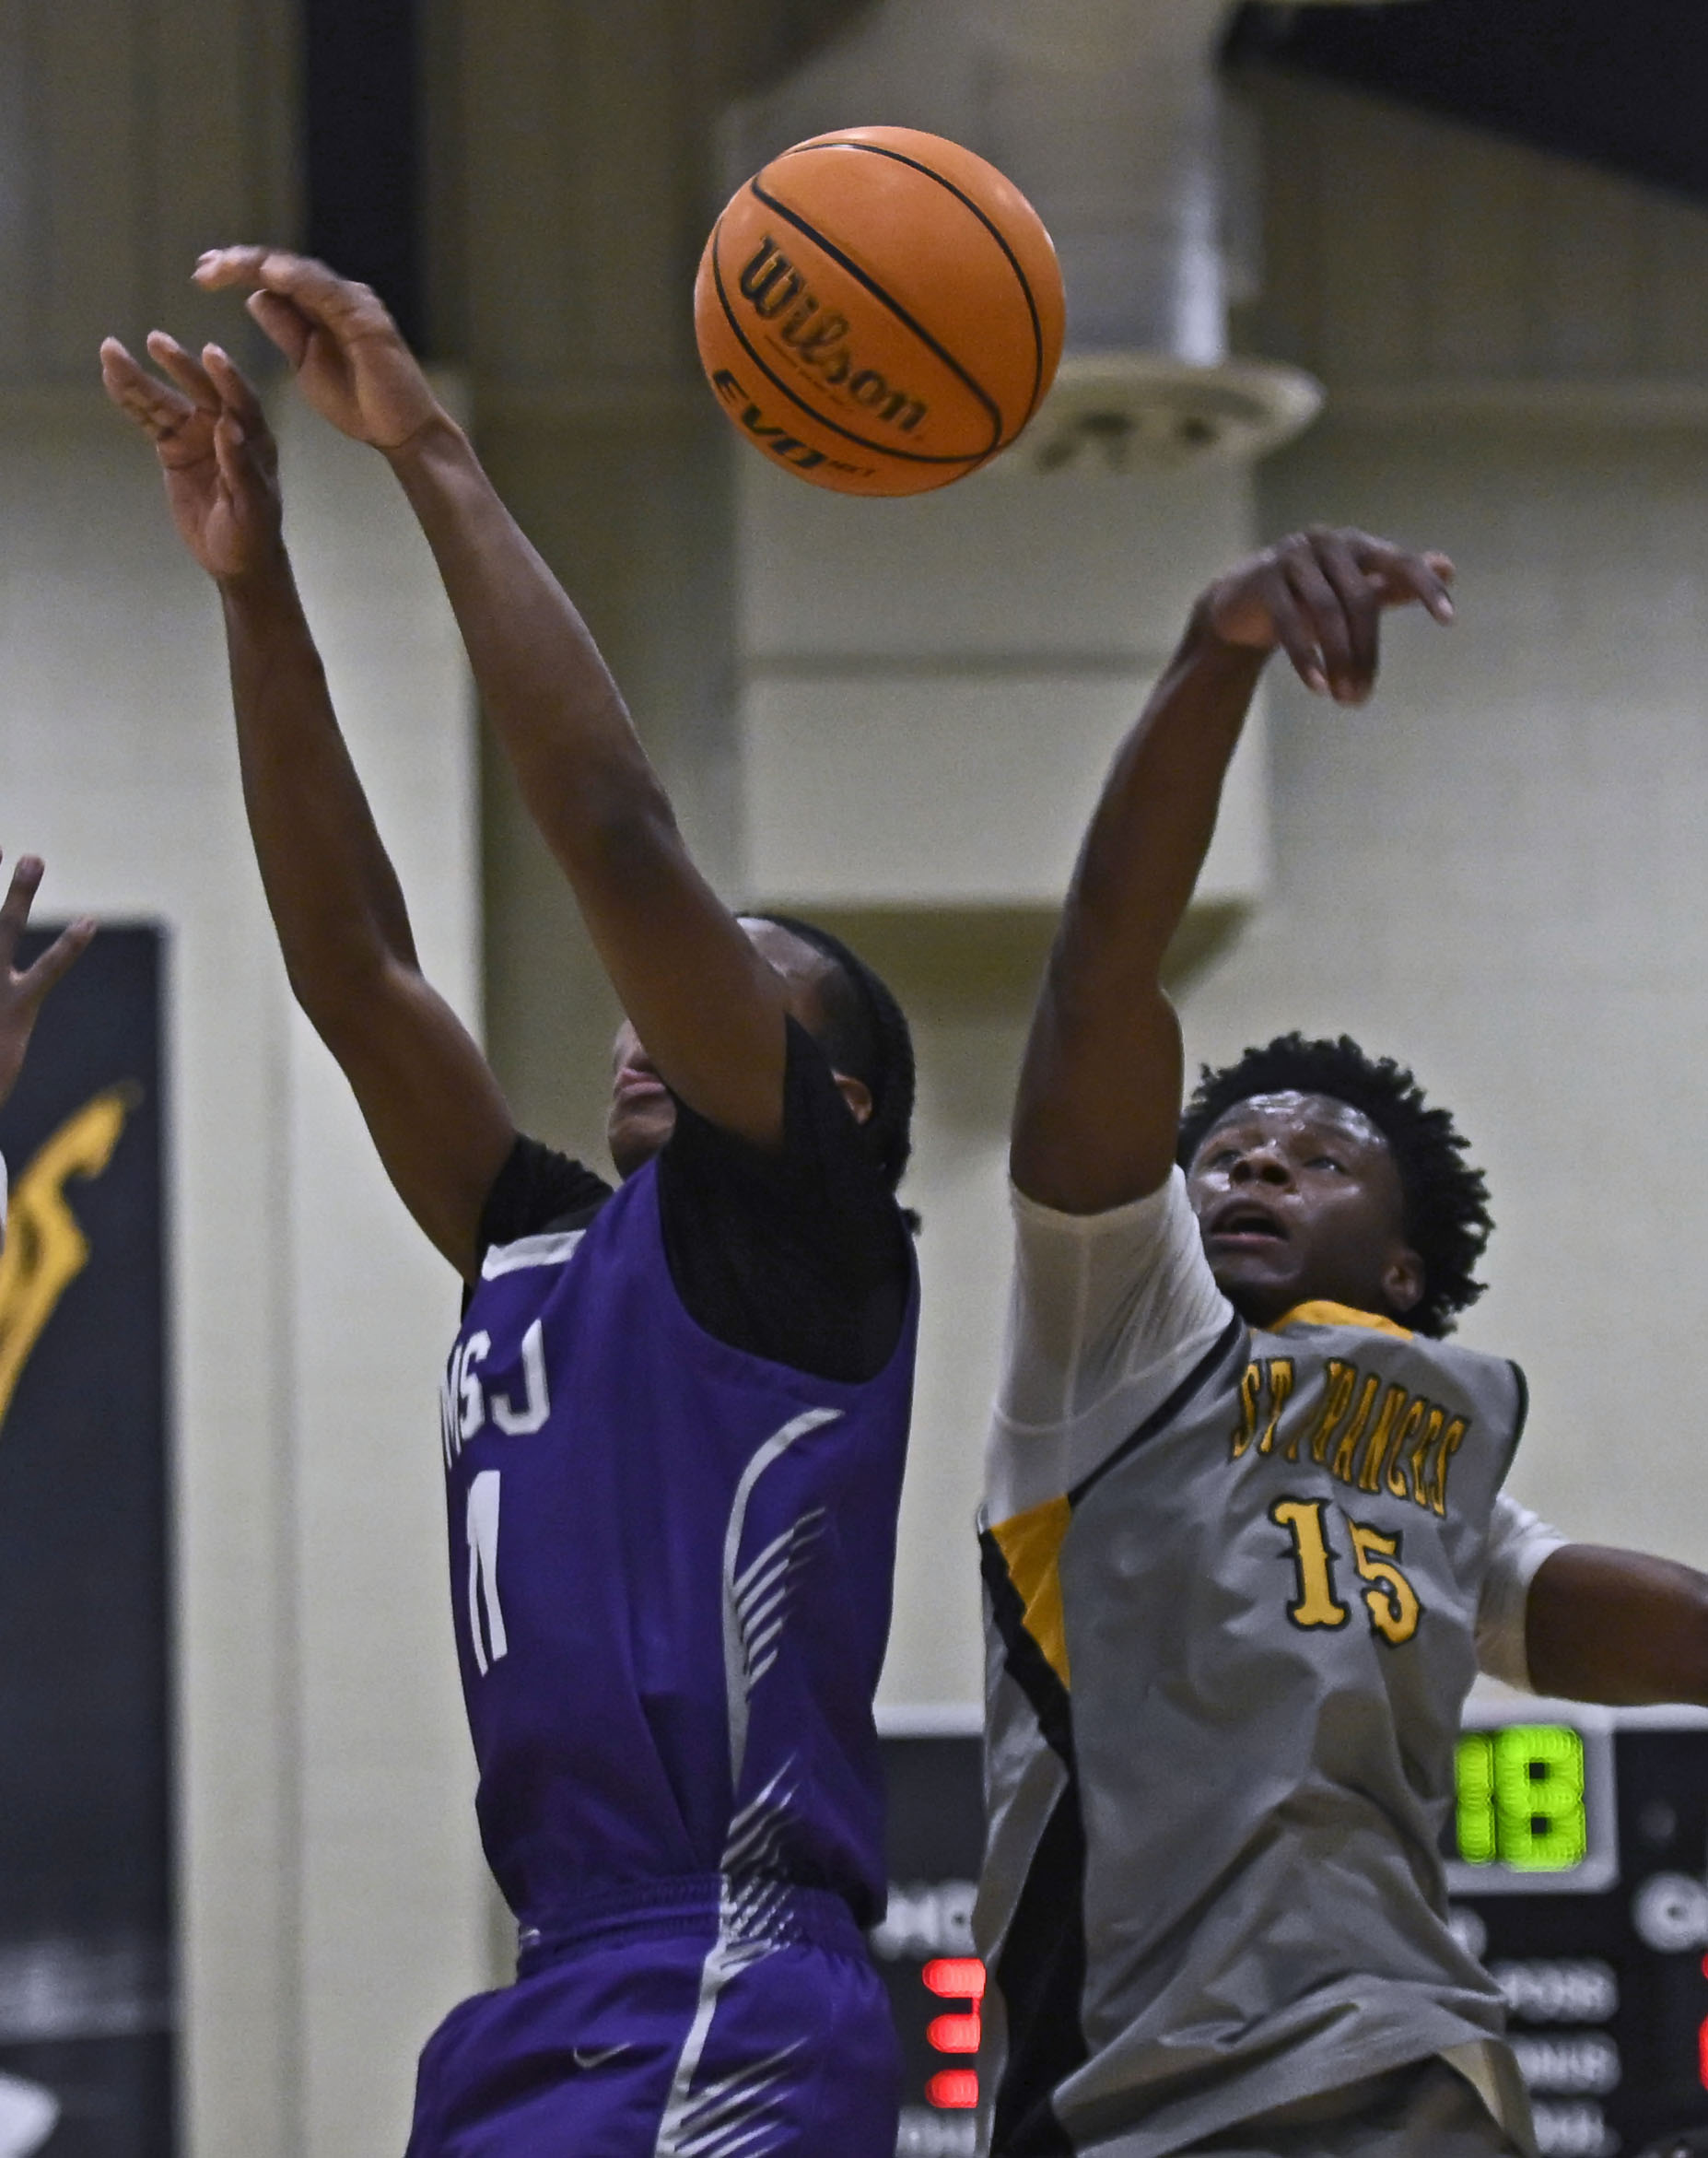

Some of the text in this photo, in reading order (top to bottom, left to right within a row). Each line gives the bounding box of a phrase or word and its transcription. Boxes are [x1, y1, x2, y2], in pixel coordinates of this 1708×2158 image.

[740, 235, 928, 431] Wilson
[714, 369, 826, 469] EVO
[439, 1318, 550, 1470] MSJ
[1284, 1358, 1471, 1519] RANCES
[1268, 1495, 1424, 1647] 15
